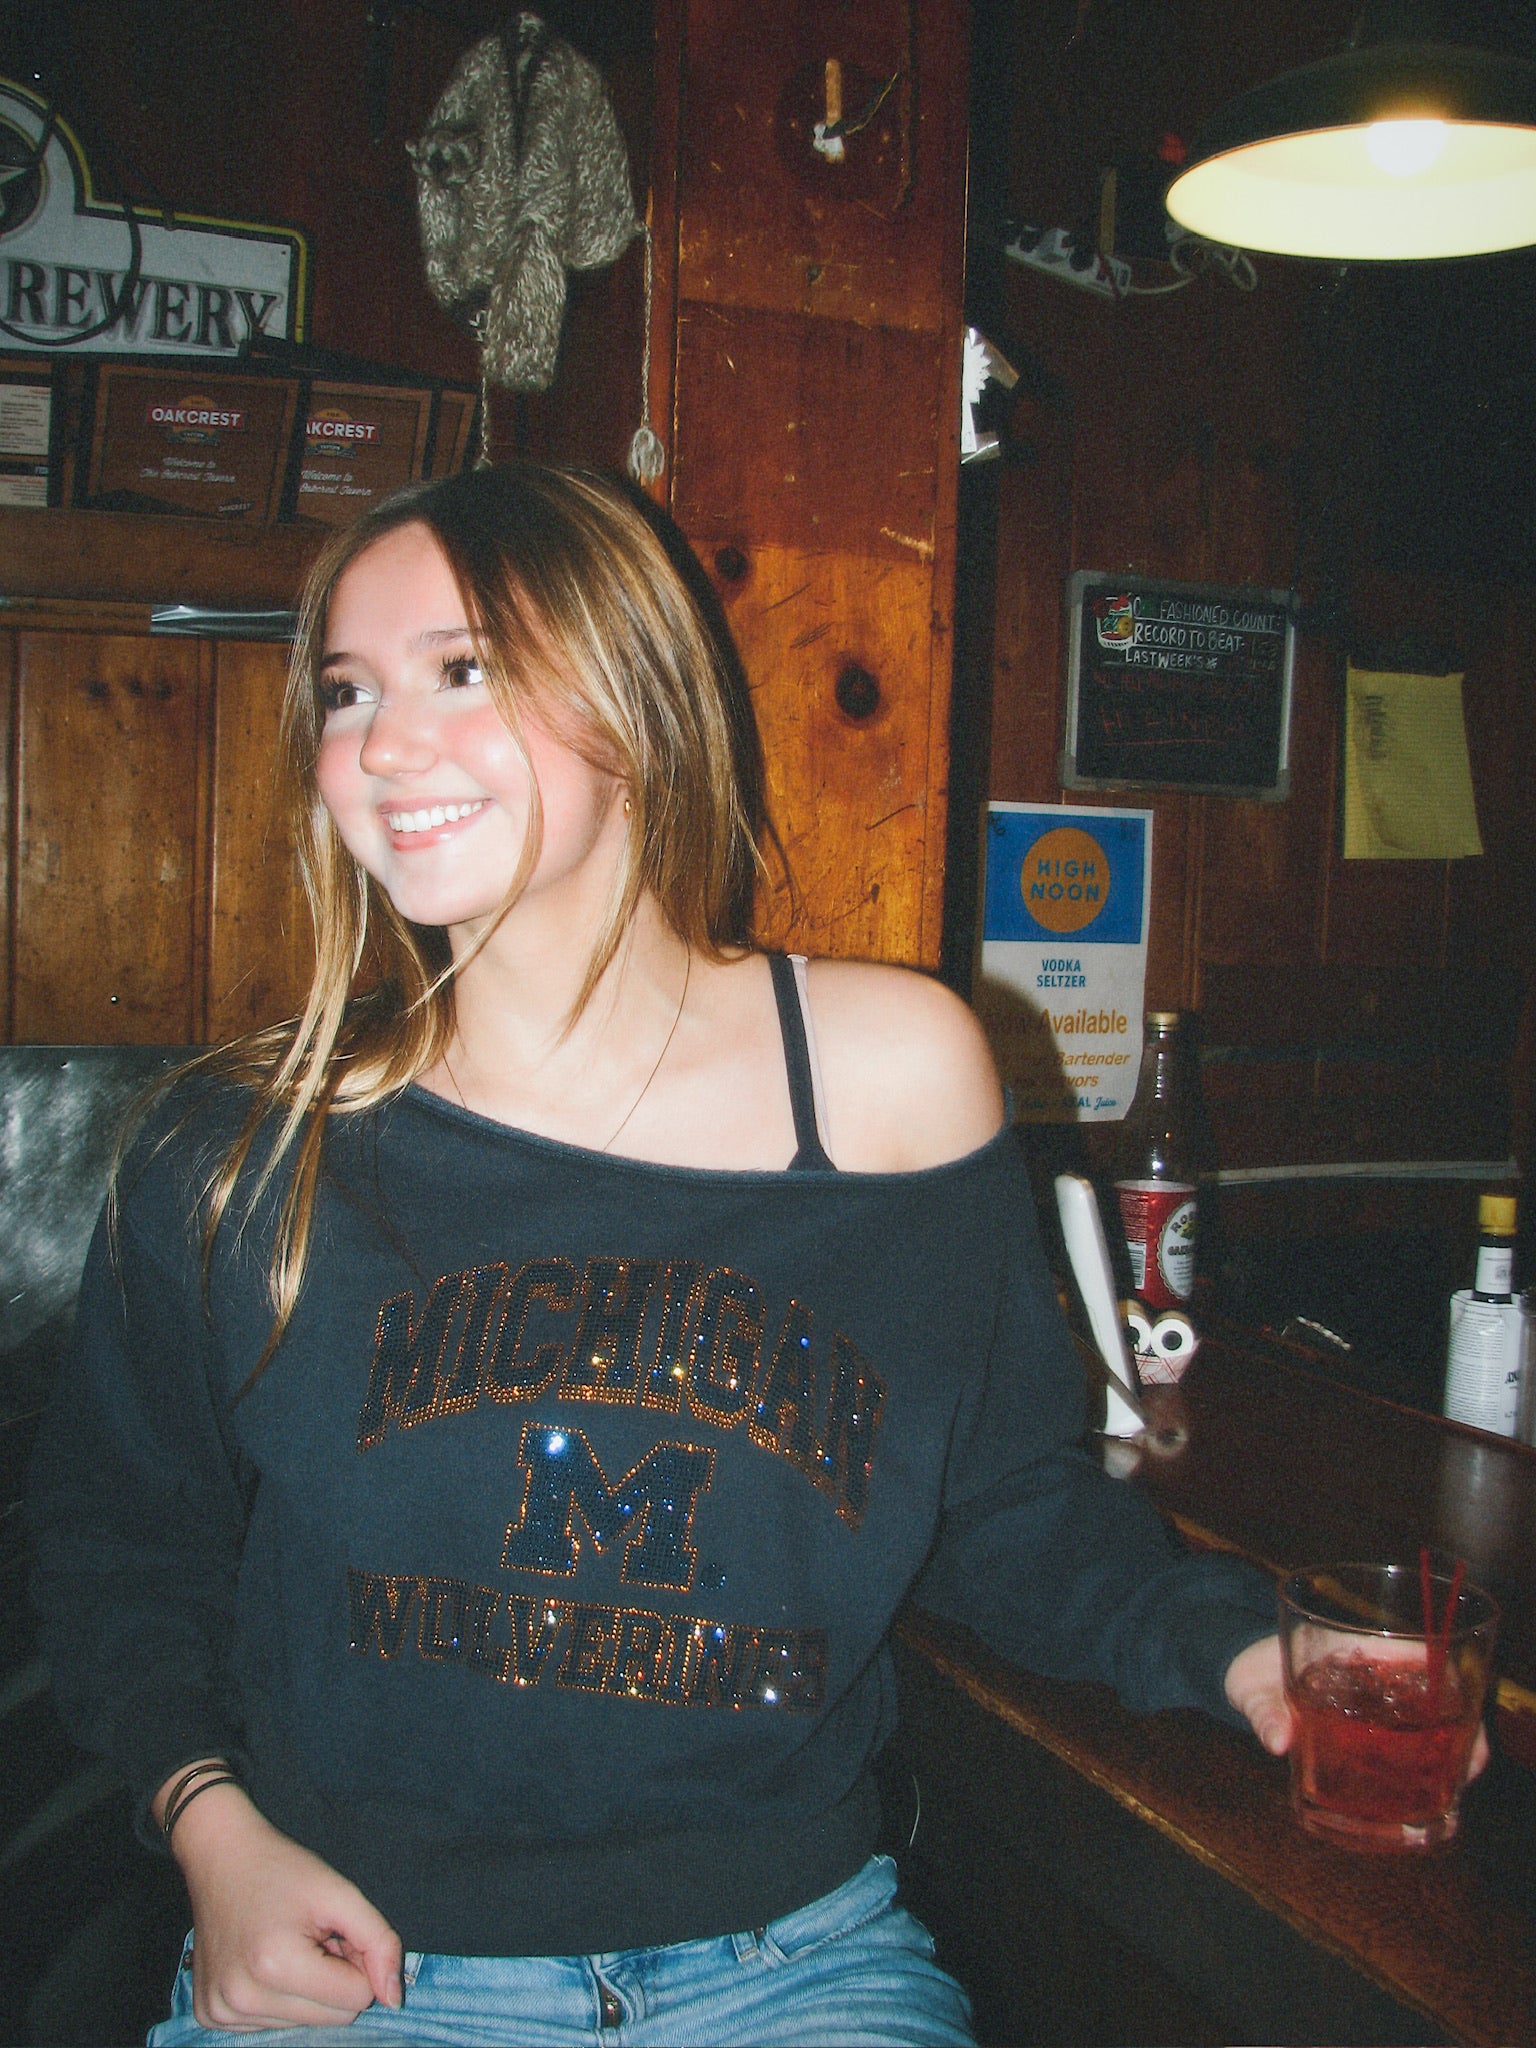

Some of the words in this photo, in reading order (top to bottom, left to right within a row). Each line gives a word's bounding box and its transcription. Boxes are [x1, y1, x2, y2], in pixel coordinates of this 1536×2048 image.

[151, 407, 241, 427] OAKCREST
[306, 421, 375, 439] KCREST
[1160, 600, 1229, 624] FASHIONED
[1134, 623, 1185, 645] RECORD
[1189, 632, 1205, 648] TO
[1037, 859, 1096, 877] HIGH
[1030, 882, 1100, 902] NOON
[1041, 959, 1081, 972] VODKA
[1036, 975, 1086, 988] SELTZER
[1038, 1008, 1128, 1035] Available
[1057, 1051, 1132, 1066] Bartender
[355, 1256, 889, 1533] MICHIGAN
[500, 1421, 717, 1592] M
[345, 1564, 830, 1716] WOLVERINES
